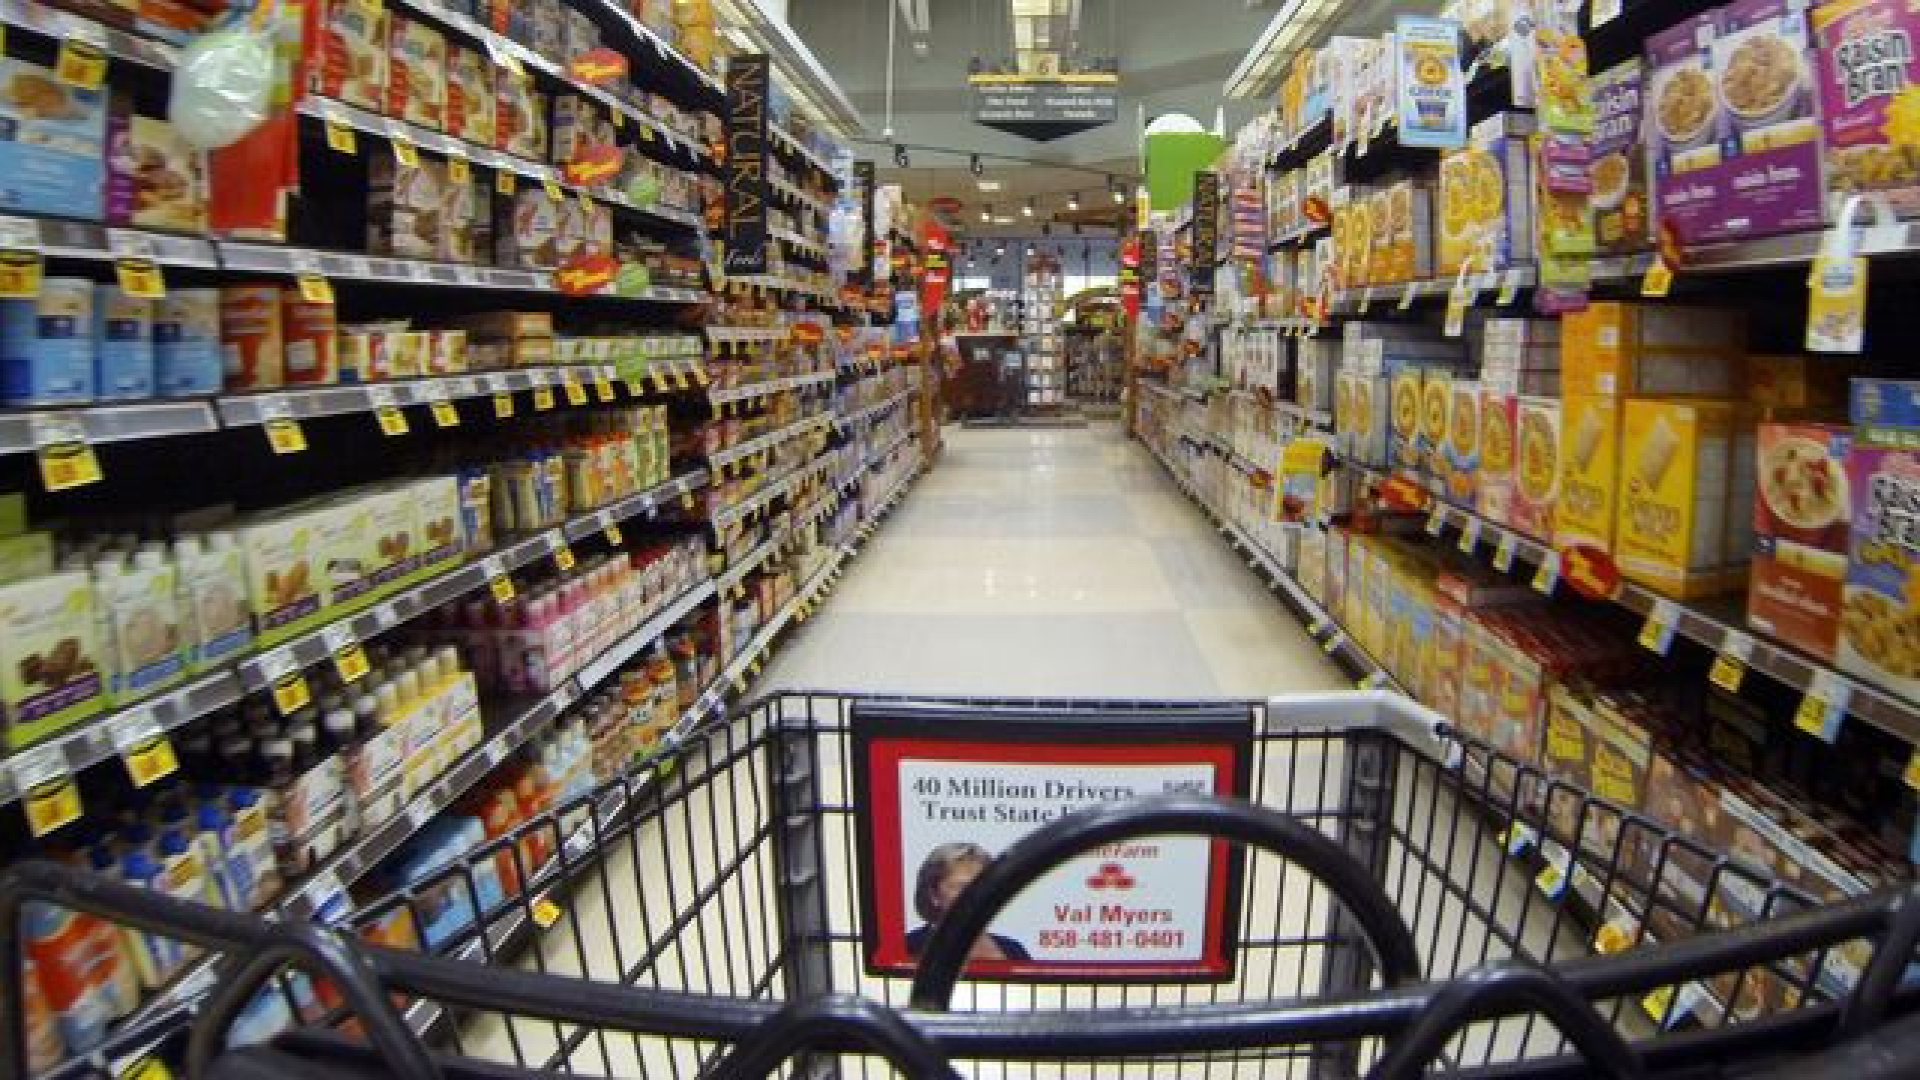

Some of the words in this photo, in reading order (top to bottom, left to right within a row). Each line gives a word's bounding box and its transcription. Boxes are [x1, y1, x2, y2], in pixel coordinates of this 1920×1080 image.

[730, 62, 762, 239] NATURAL
[912, 776, 941, 797] 40
[949, 777, 1037, 799] Million
[1045, 780, 1135, 801] Drivers
[920, 800, 987, 821] Trust
[993, 803, 1052, 823] State
[1054, 904, 1092, 924] Val
[1101, 904, 1173, 926] Myers
[1038, 929, 1185, 949] 858-481-0401
